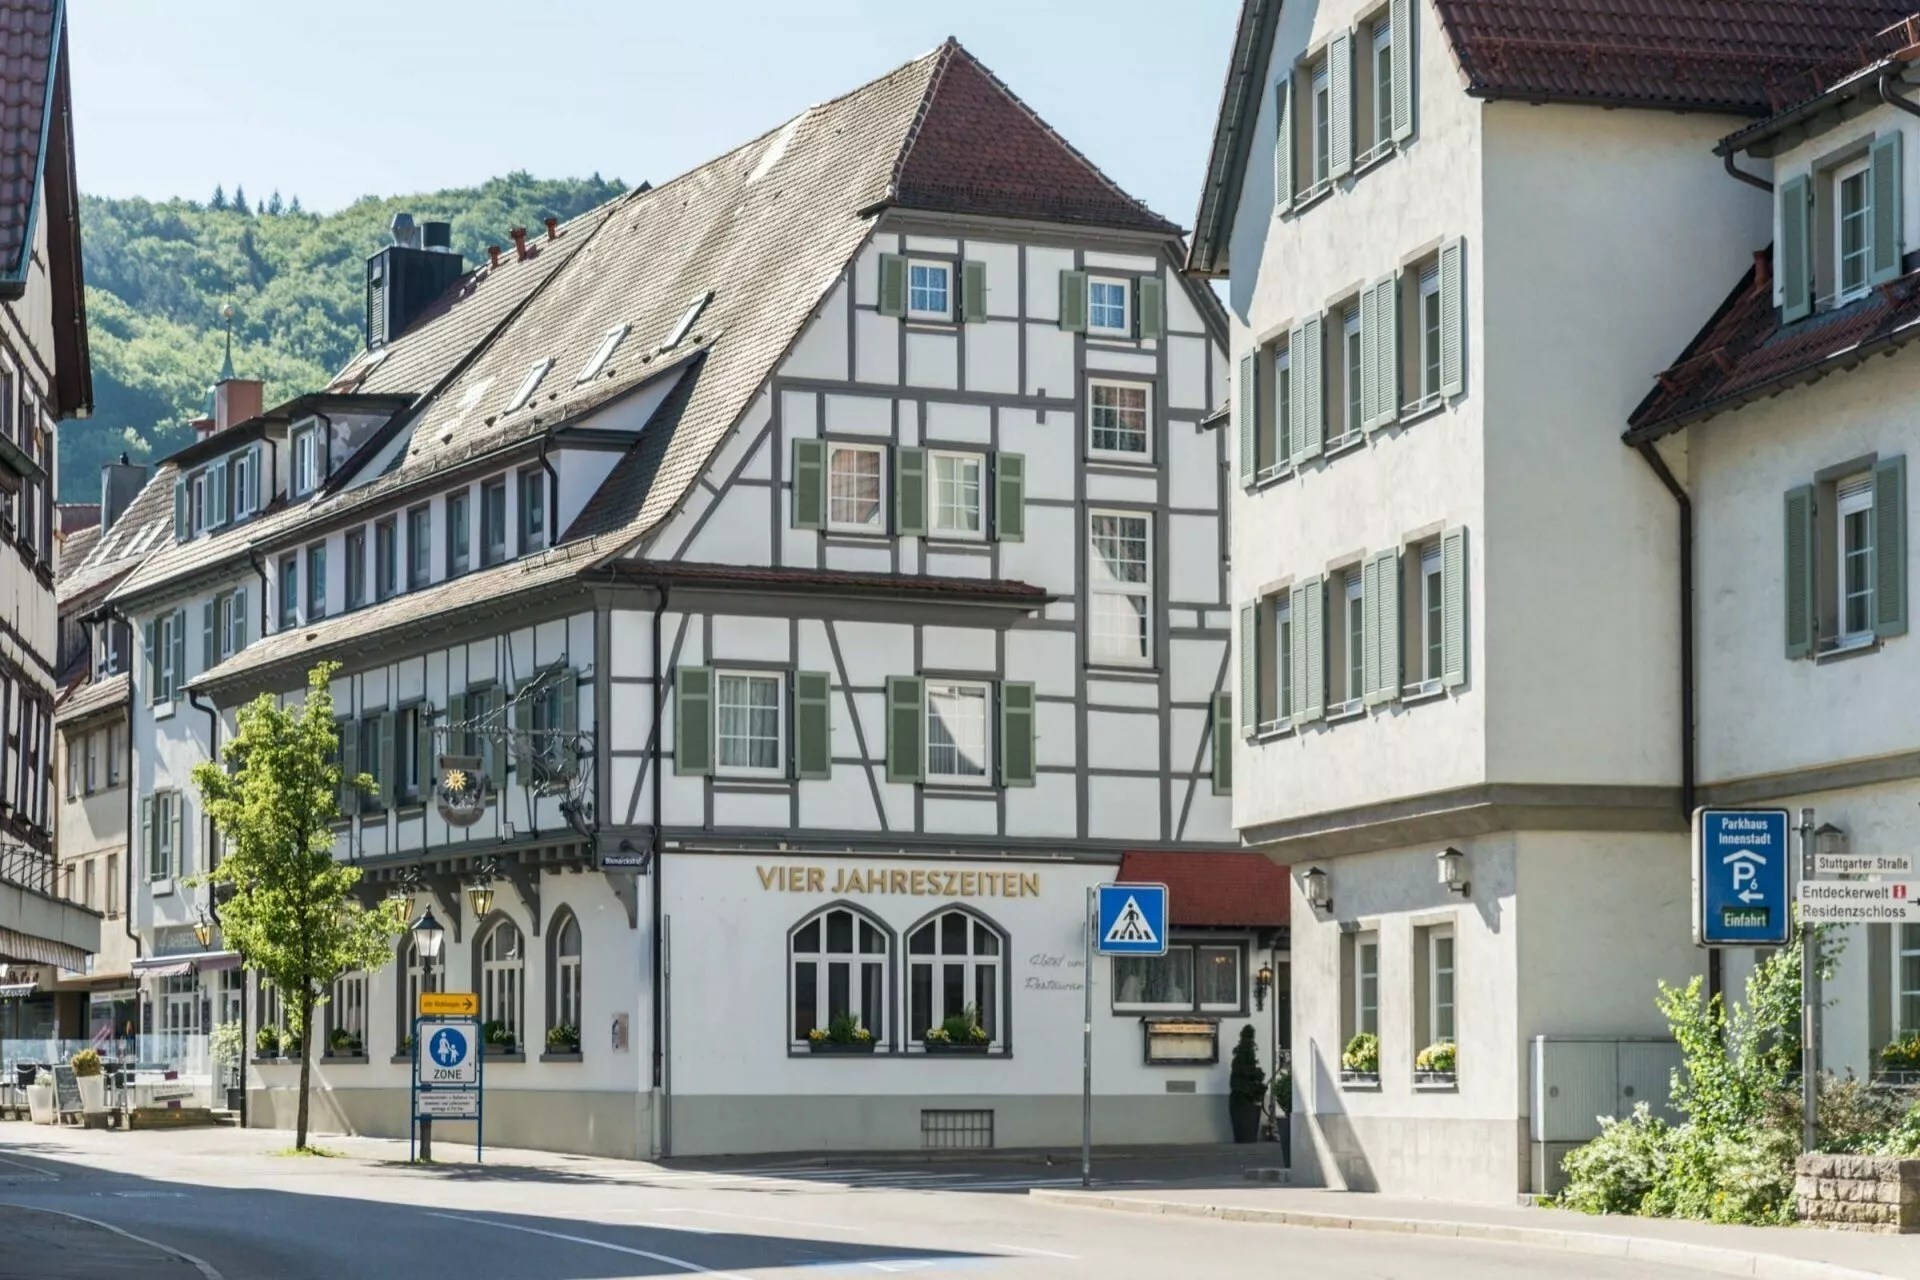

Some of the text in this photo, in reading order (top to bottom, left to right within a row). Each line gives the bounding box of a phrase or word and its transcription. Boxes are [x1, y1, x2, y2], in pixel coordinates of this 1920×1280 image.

[1722, 817, 1768, 830] Parkhaus
[1719, 833, 1771, 845] Innenstadt
[1819, 857, 1908, 871] Stuttgarter Straße
[756, 866, 1040, 897] VIER JAHRESZEITEN
[1802, 885, 1889, 899] Entdeckerwelt
[1802, 904, 1906, 917] Residenzschloss
[1724, 912, 1767, 927] Einfahrt
[1029, 952, 1066, 967] Hotel
[1024, 976, 1084, 990] Restauran
[433, 1069, 462, 1080] ZONE
